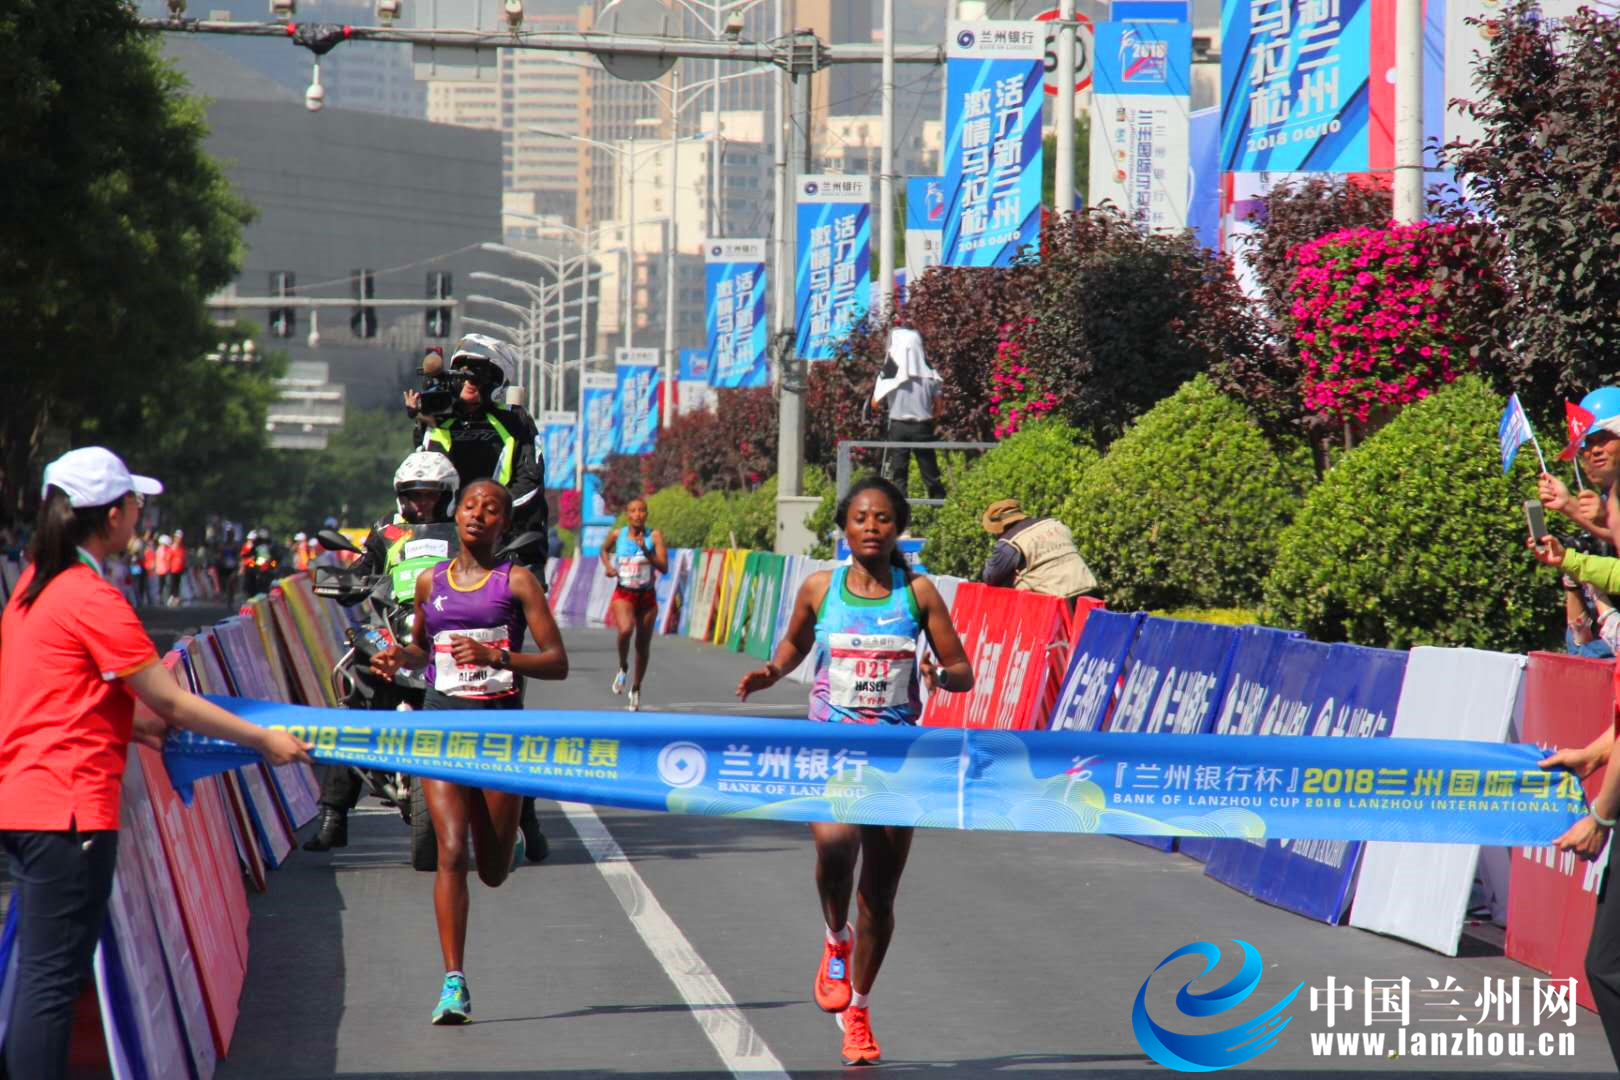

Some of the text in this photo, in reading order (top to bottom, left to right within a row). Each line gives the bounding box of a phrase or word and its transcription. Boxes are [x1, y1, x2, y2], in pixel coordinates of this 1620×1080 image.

[980, 30, 1034, 44] 兰州银行
[1247, 119, 1342, 152] 2018 06/10
[992, 73, 1025, 231] 活力新兰州
[821, 181, 864, 192] 兰州银行
[958, 238, 986, 252] 2018
[855, 681, 888, 692] HASEN
[395, 757, 522, 774] INTERNATIONAL
[529, 765, 619, 779] MARATHON
[719, 744, 868, 783] 兰州银行
[718, 781, 761, 794] BANK
[765, 784, 786, 795] OF
[1113, 793, 1154, 805] BANK
[1162, 794, 1182, 805] OF
[1188, 795, 1263, 808] LANZHOU
[1269, 797, 1300, 808] CUP
[1305, 798, 1342, 809] 2018
[1349, 798, 1425, 811] LANZHOU
[1431, 800, 1560, 814] INTERNATIONAL
